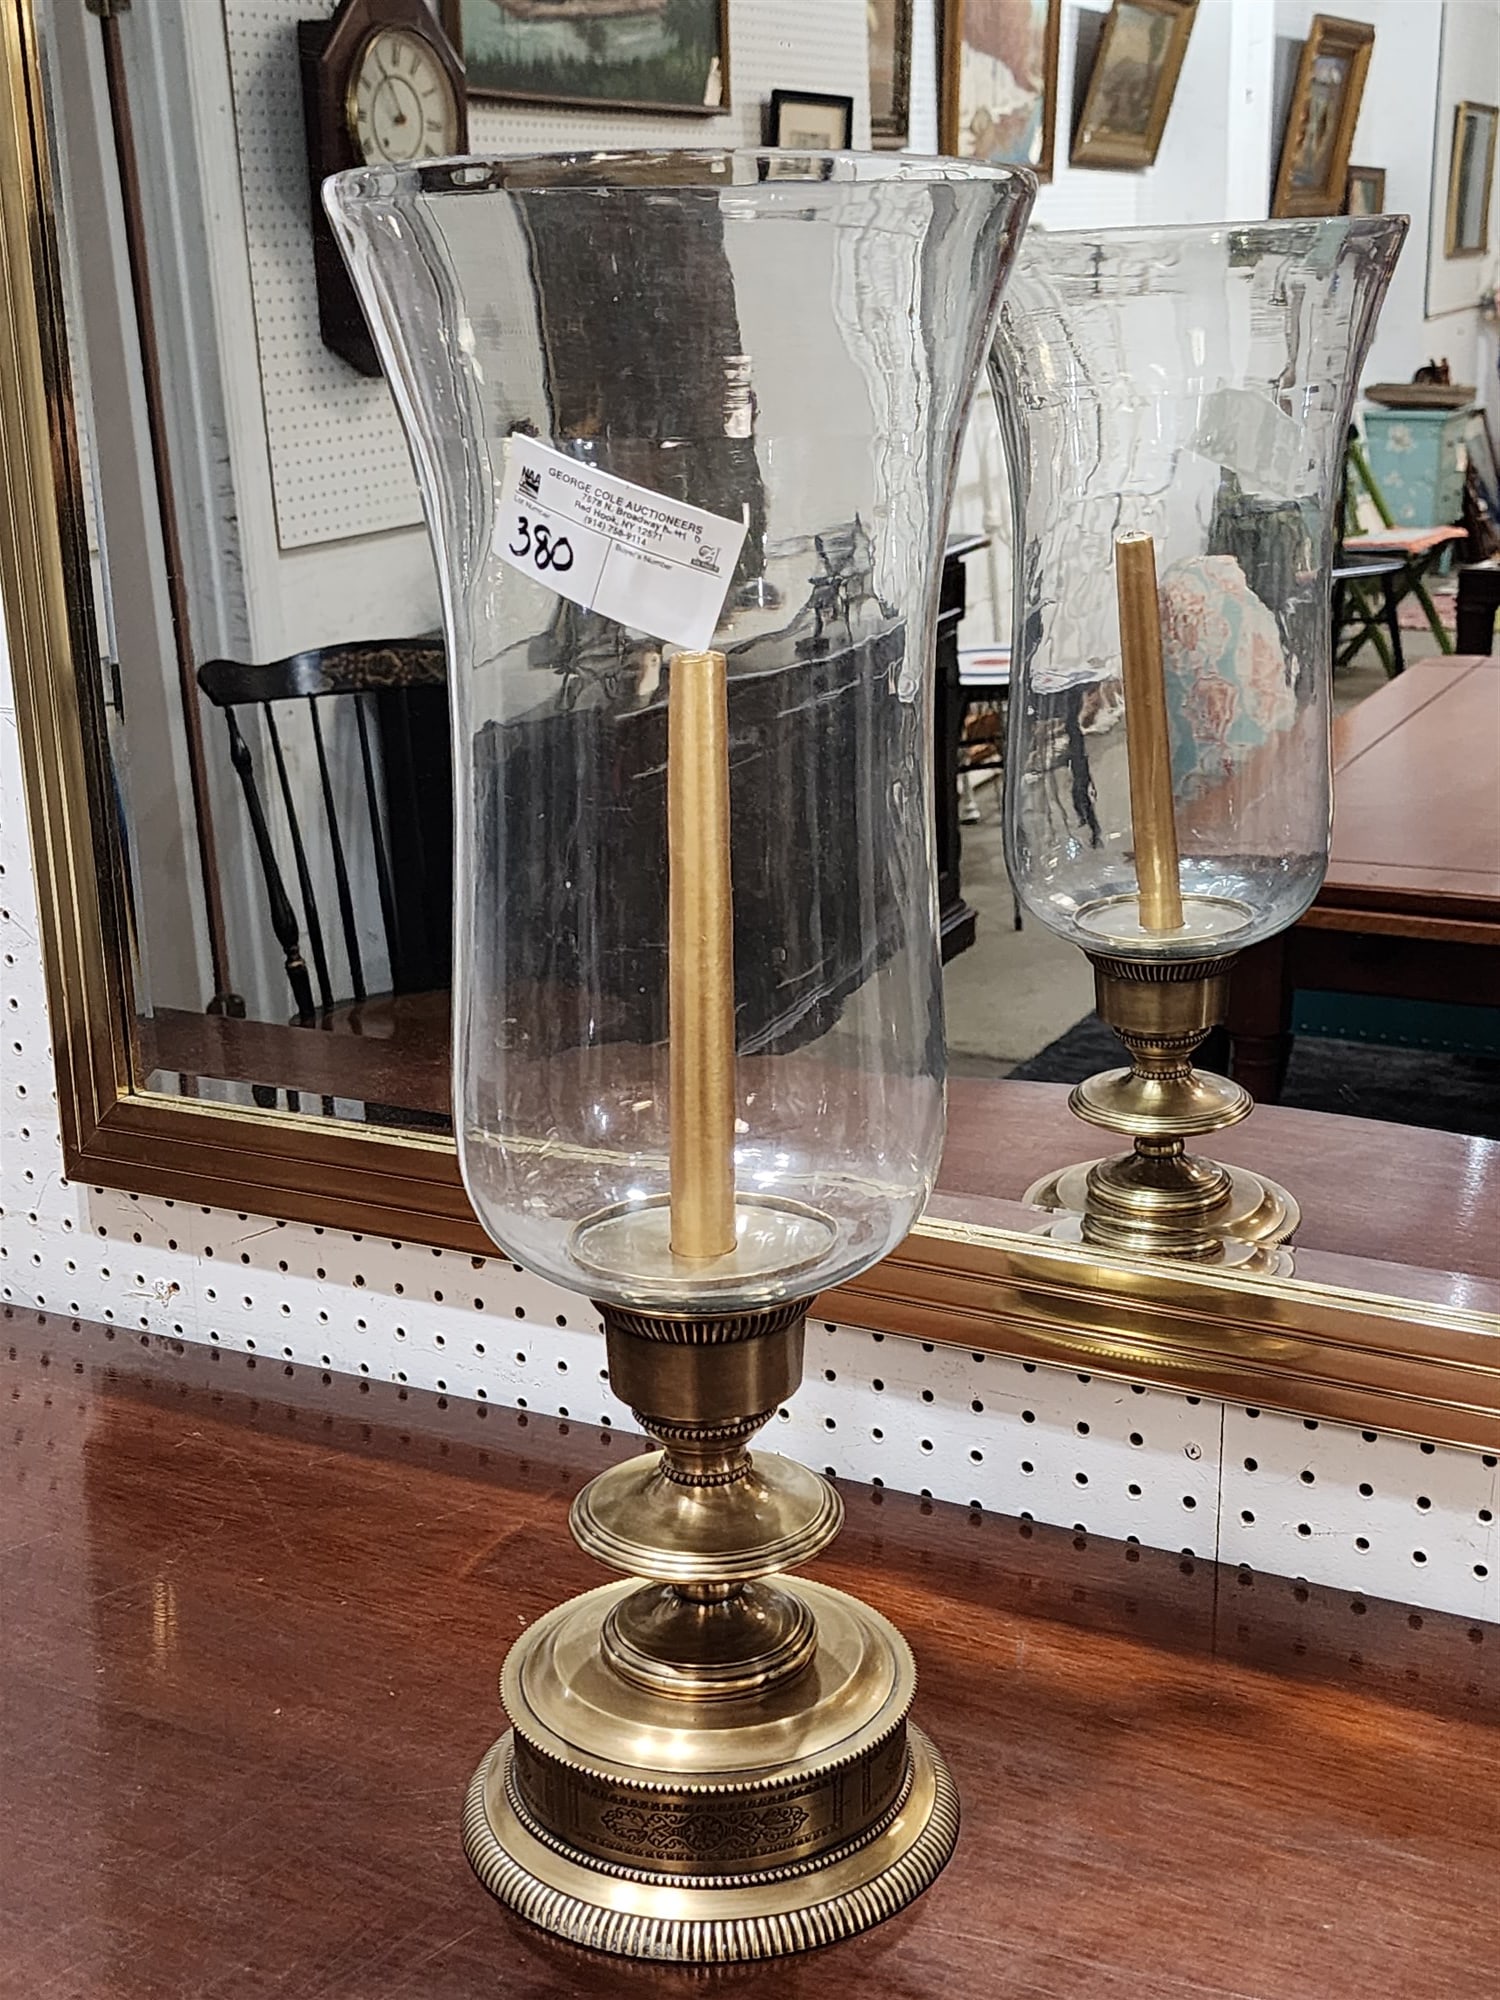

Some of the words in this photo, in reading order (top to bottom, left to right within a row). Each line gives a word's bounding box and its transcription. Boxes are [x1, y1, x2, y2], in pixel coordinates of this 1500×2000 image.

[548, 467, 592, 493] GEORGE
[594, 488, 624, 506] COLE
[625, 501, 704, 535] AUCTIONEERS
[574, 500, 591, 513] Red
[622, 520, 635, 531] NY
[616, 508, 661, 533] Broadway
[509, 516, 574, 571] 380
